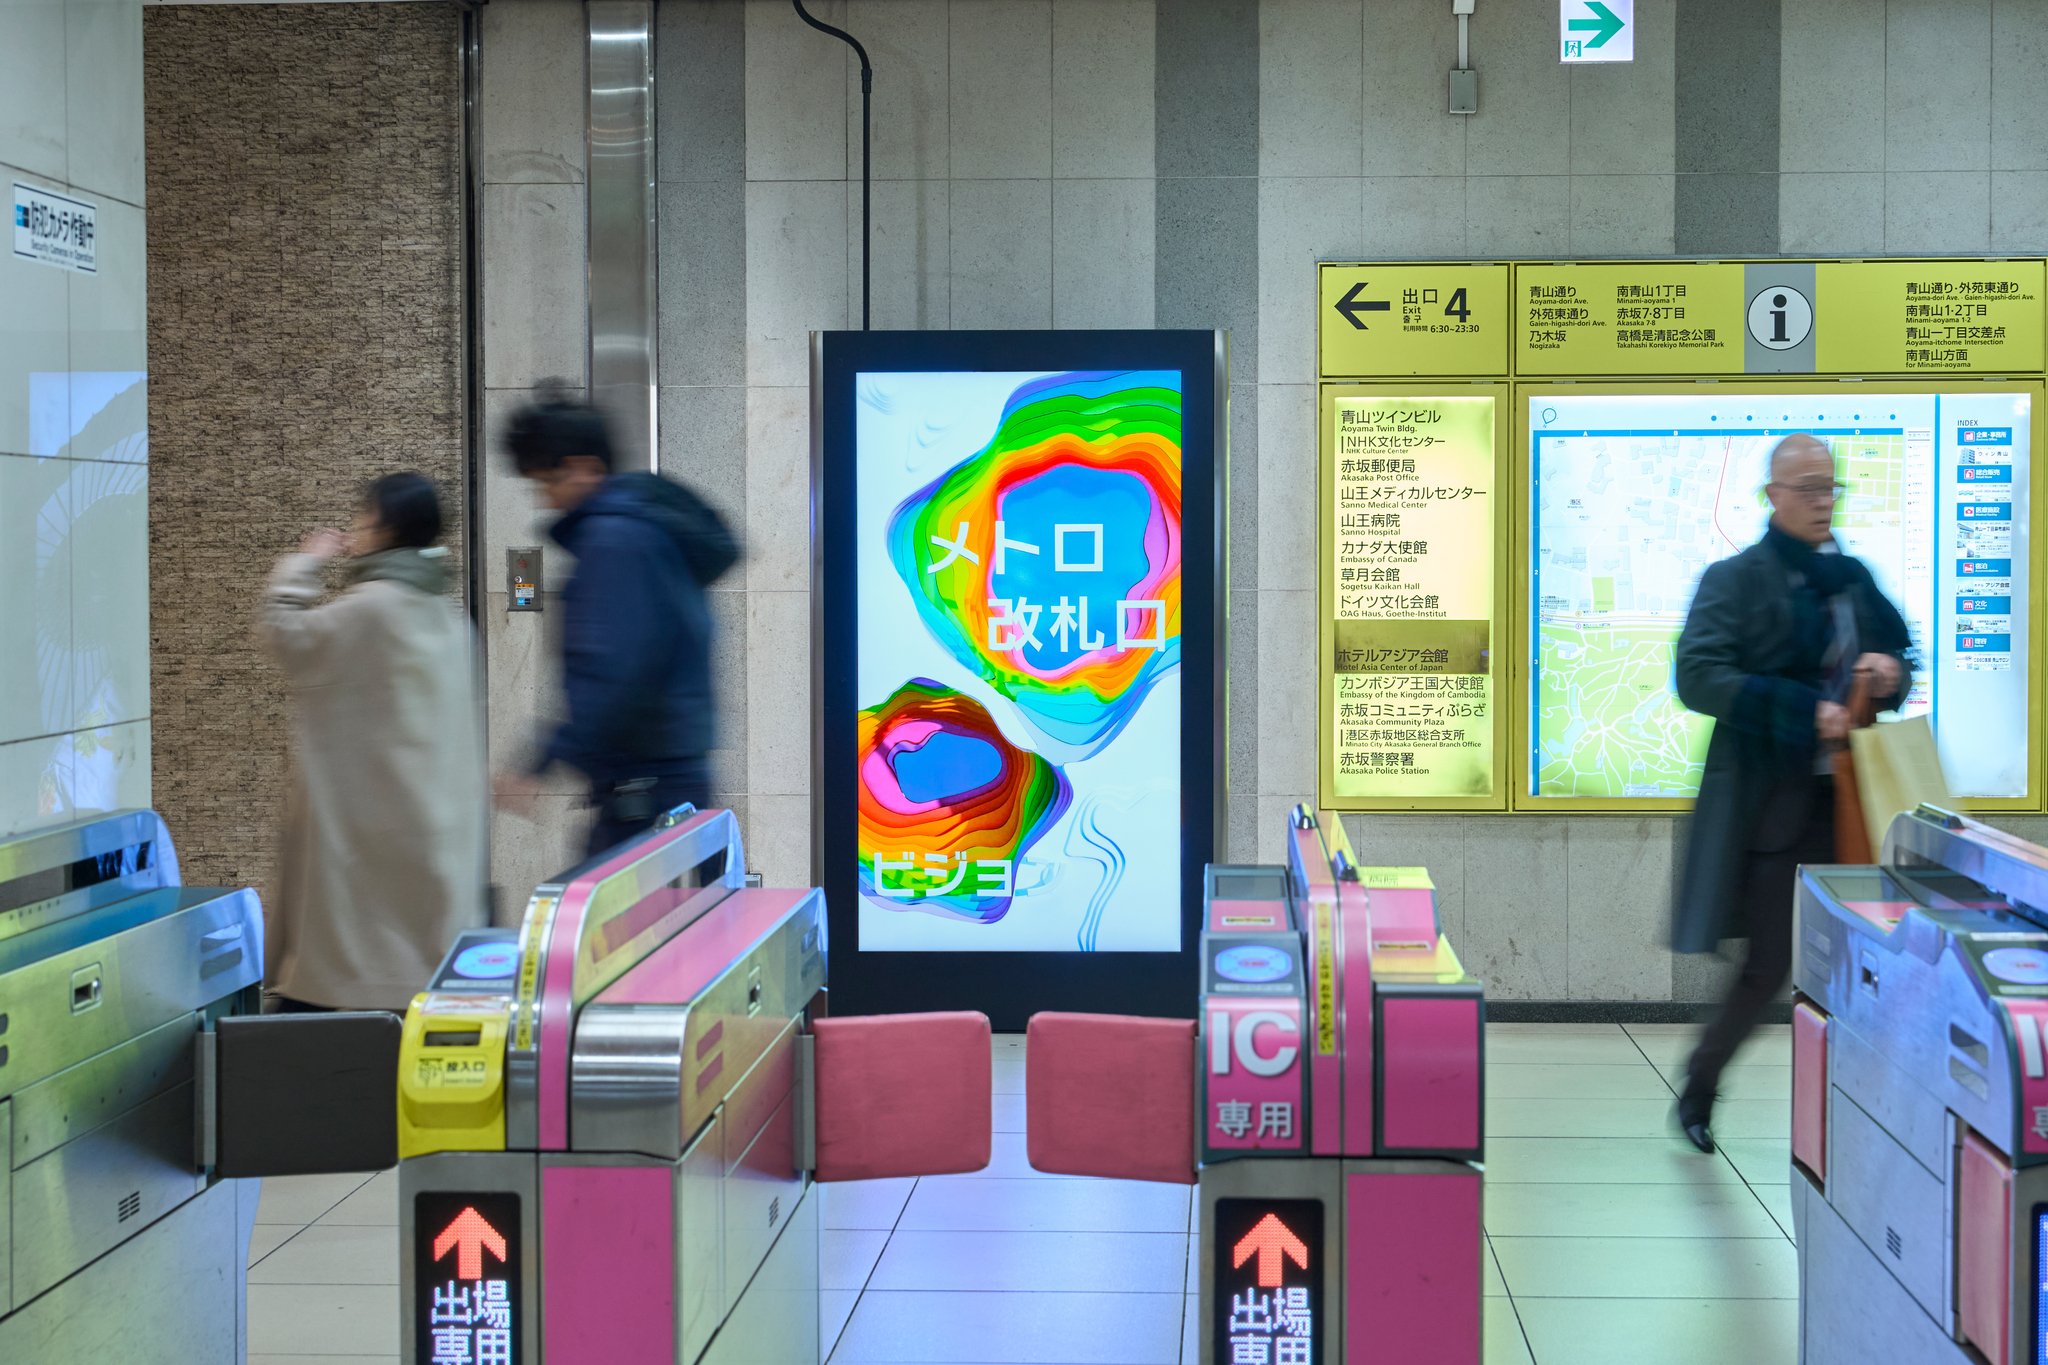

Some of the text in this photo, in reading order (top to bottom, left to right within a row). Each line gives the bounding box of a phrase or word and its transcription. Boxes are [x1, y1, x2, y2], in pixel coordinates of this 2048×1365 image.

[1529, 285, 1577, 298] 青山通り
[1616, 284, 1687, 298] 南青山1丁目
[1403, 287, 1471, 323] 出口 4
[1529, 298, 1574, 306] Aoyama-dori
[1616, 297, 1670, 306] Minami-aoyama
[1403, 306, 1422, 314] Exit
[1529, 307, 1589, 320] 外苑東通り
[1403, 315, 1422, 324] 출구
[1529, 320, 1591, 328] Gaien-higashi-dori
[1616, 319, 1645, 327] Akasaka
[1529, 330, 1567, 343] 乃木坂
[1616, 329, 1716, 342] 高橋是清記念公園
[1906, 326, 2006, 339] 青山一丁目交差点
[1529, 342, 1560, 350] Nogizaka
[1616, 341, 1725, 350] Takahashi Korekiyo Memorial Park
[1906, 349, 1968, 361] 南青山方面
[1917, 361, 1971, 369] Minami-aoyama
[1341, 410, 1442, 424] 青山ツインビル
[1341, 425, 1374, 433] Aoyama
[1397, 424, 1418, 433] Bldg.
[1347, 436, 1445, 448] NHK文化センター
[1341, 459, 1415, 473] 赤坂郵便局
[1341, 486, 1487, 500] 山王メディカルセンター
[1341, 501, 1427, 509] Sanno Medical Center
[1341, 513, 1401, 528] 山王病院
[1368, 528, 1401, 537] Hospital
[927, 521, 1104, 575] メトロ
[1341, 540, 1428, 555] カナダ大使館
[1340, 556, 1375, 564] Embassy
[1376, 555, 1386, 563] of
[1341, 568, 1400, 582] 草月会館
[1340, 583, 1373, 591] Sogetsu
[1341, 595, 1439, 609] ドイツ文化会館
[1340, 610, 1447, 618] OAG Haus, Goethe-Institut
[987, 595, 1166, 653] 改札口
[1337, 648, 1449, 663] ホテルアジア会館
[1409, 663, 1418, 671] of
[1420, 664, 1443, 672] Japan
[1341, 676, 1484, 691] カンボジア王国大使館
[1340, 691, 1486, 700] Embassy of the Kingdom of Cambodia
[1340, 703, 1486, 718] 赤坂コミュニティぷらざ
[1340, 718, 1445, 727] Akasaka Community Plaza
[1346, 729, 1465, 741] 港区赤坂地区総合支所
[1370, 741, 1382, 749] City
[1340, 752, 1414, 767] 赤坂警察署
[1340, 767, 1430, 775] Akasaka Police Station
[1211, 1011, 1299, 1077] IC
[1215, 1100, 1294, 1140] 専用
[431, 1279, 511, 1329] 出場
[1230, 1287, 1312, 1336] 出場
